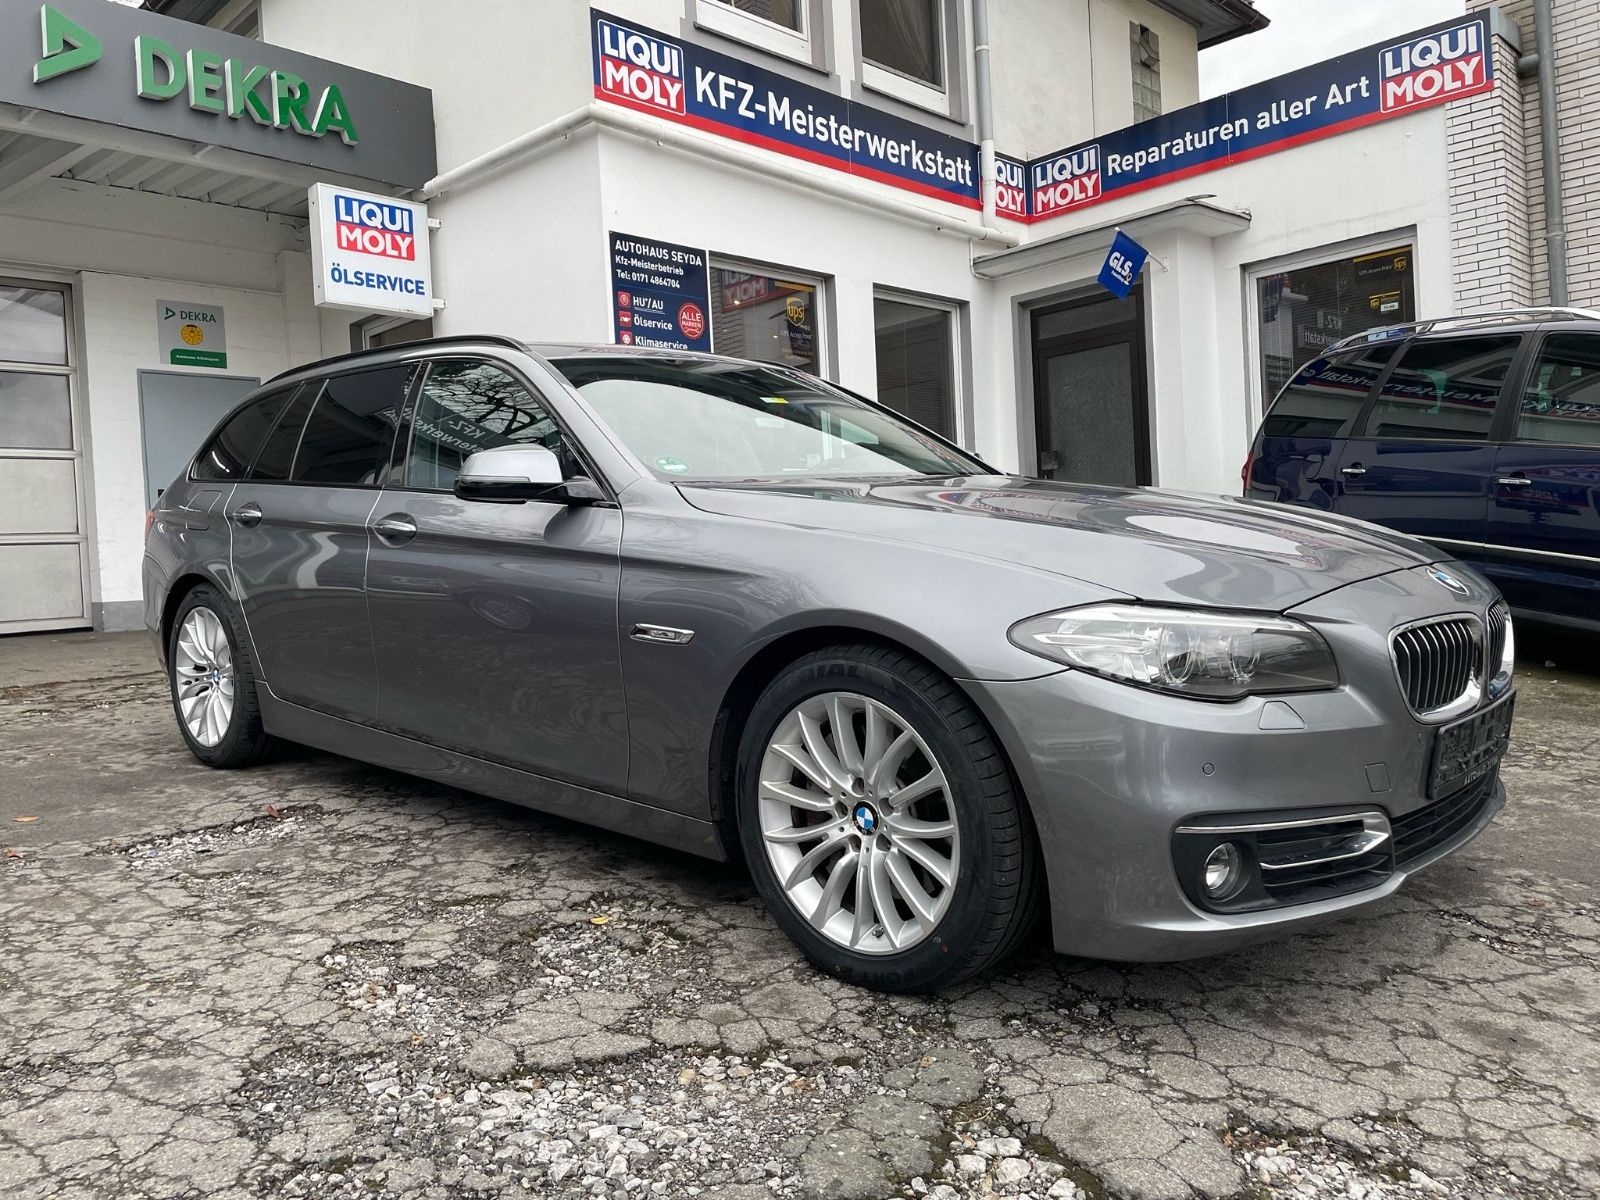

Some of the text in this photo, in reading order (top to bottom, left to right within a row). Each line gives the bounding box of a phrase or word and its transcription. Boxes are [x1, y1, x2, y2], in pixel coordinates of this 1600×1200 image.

[604, 25, 680, 78] LIQUI
[1385, 26, 1477, 78] LIQUI
[135, 35, 359, 146] DEKRA
[605, 60, 682, 109] MOLY
[1386, 55, 1482, 108] MOLY
[694, 66, 973, 187] KFZ-Meisterwerkstatt
[1107, 76, 1370, 177] Reparaturen aller Art
[995, 160, 1023, 189] QUI
[1036, 148, 1096, 188] LIQUI
[996, 185, 1024, 212] OLY
[1037, 173, 1098, 212] MOLY
[338, 198, 410, 233] LIQUI
[340, 225, 413, 258] MOLY
[615, 240, 702, 267] AUTOHAUS SEYDA
[331, 262, 425, 296] ÖLSERVICE
[615, 255, 684, 276] Kfz-Meisterbetrieb
[616, 269, 680, 288] Tel: 0171 4864704
[1109, 251, 1133, 277] GLS
[180, 310, 216, 323] DEKRA
[634, 313, 673, 330] Ölservice
[682, 312, 701, 322] ALLE
[788, 305, 803, 322] ups
[635, 335, 688, 350] Klimaservice
